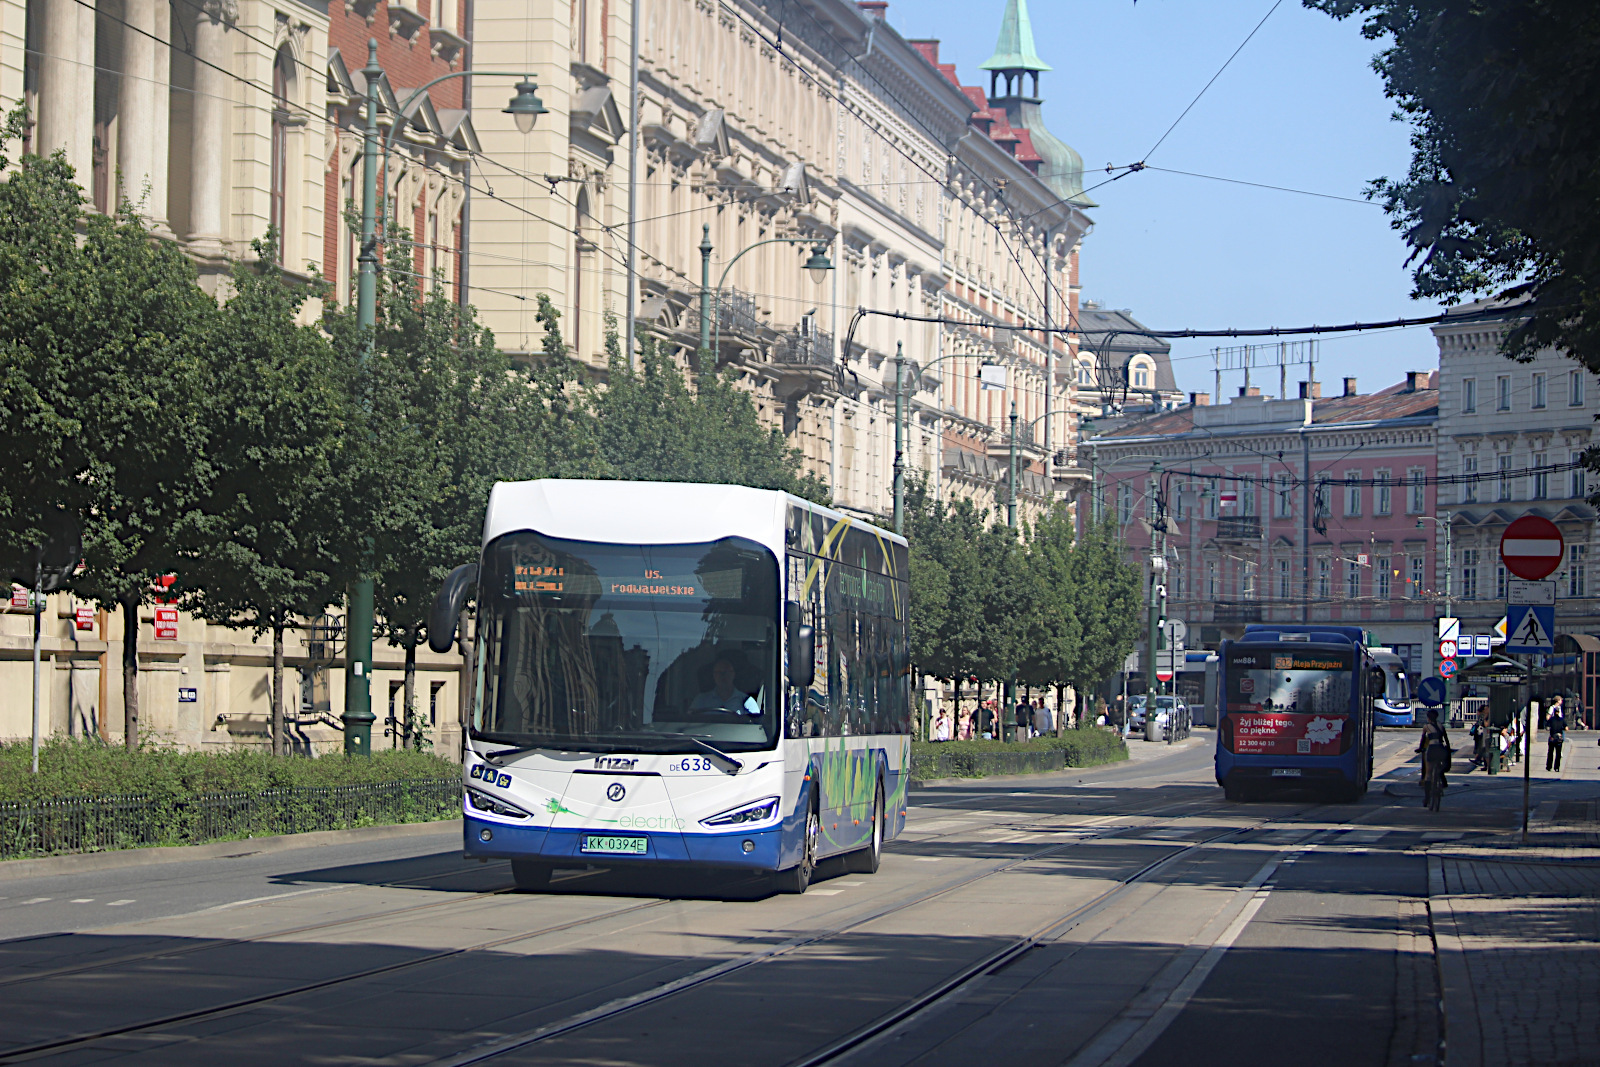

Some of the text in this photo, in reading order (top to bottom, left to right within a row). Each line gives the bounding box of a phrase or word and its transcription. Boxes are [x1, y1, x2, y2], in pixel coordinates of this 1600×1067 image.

[1293, 660, 1310, 668] Aleja
[1239, 717, 1295, 728] Żyj bliżej tego,
[1250, 726, 1278, 735] piękne.
[619, 813, 686, 830] electric
[589, 838, 645, 851] KK 0394E
